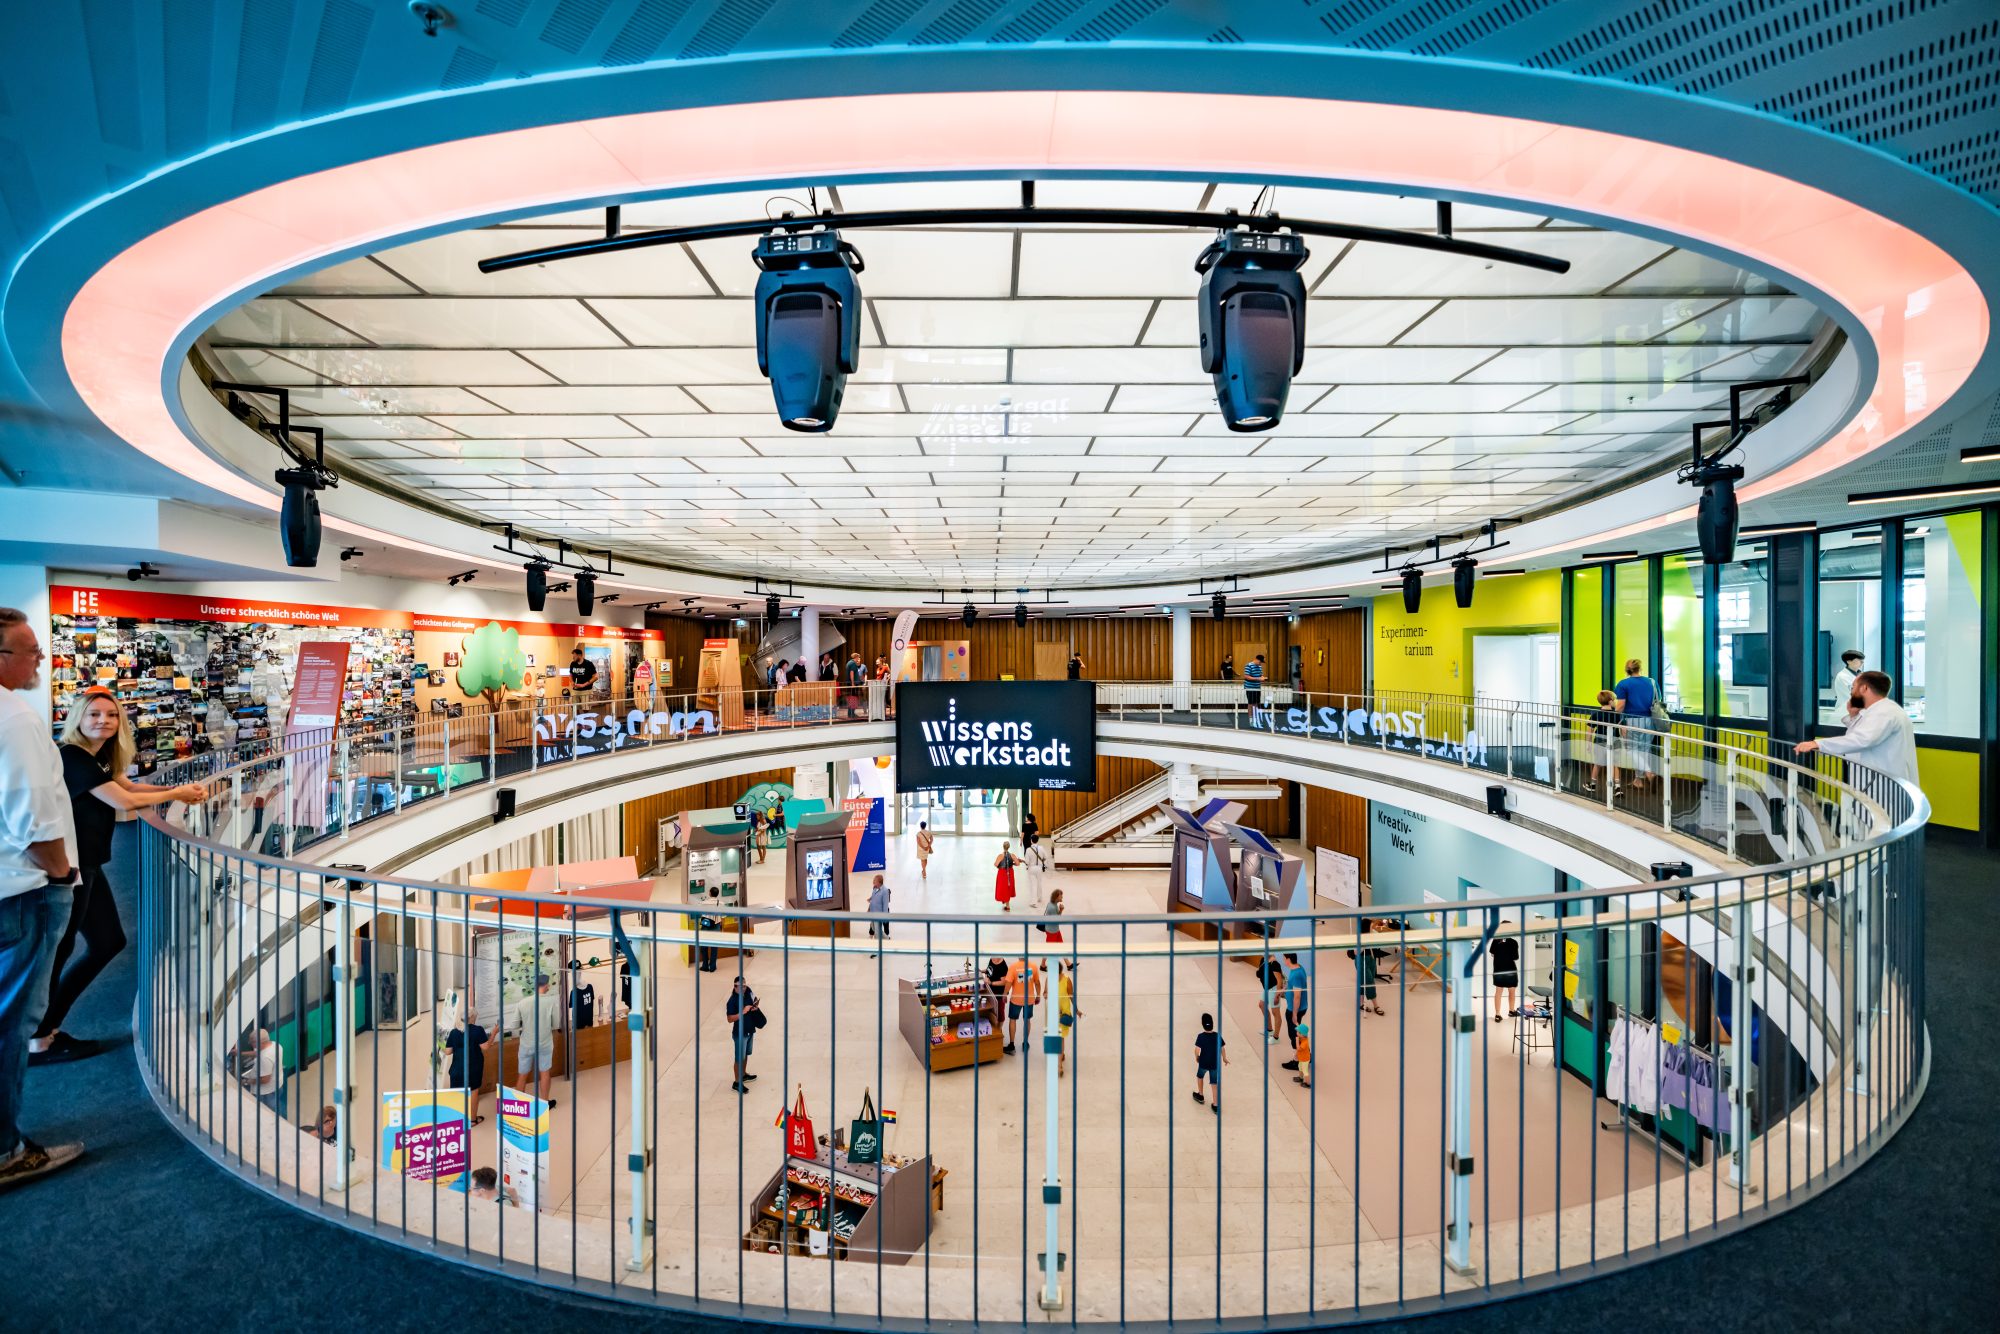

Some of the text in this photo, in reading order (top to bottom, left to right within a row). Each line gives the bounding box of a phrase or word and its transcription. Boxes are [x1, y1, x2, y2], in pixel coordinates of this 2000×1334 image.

[200, 605, 340, 621] Unsere schrecklich schöne Welt
[1381, 624, 1428, 642] Experimen-
[1404, 642, 1434, 656] tarium
[921, 698, 1033, 742] Wissens
[928, 738, 1071, 767] Werkstadt
[851, 810, 866, 818] ein
[1378, 810, 1412, 834] Kreativ-
[1391, 833, 1414, 856] Werk
[399, 1126, 461, 1146] Gewnn-
[412, 1134, 465, 1164] Spiel
